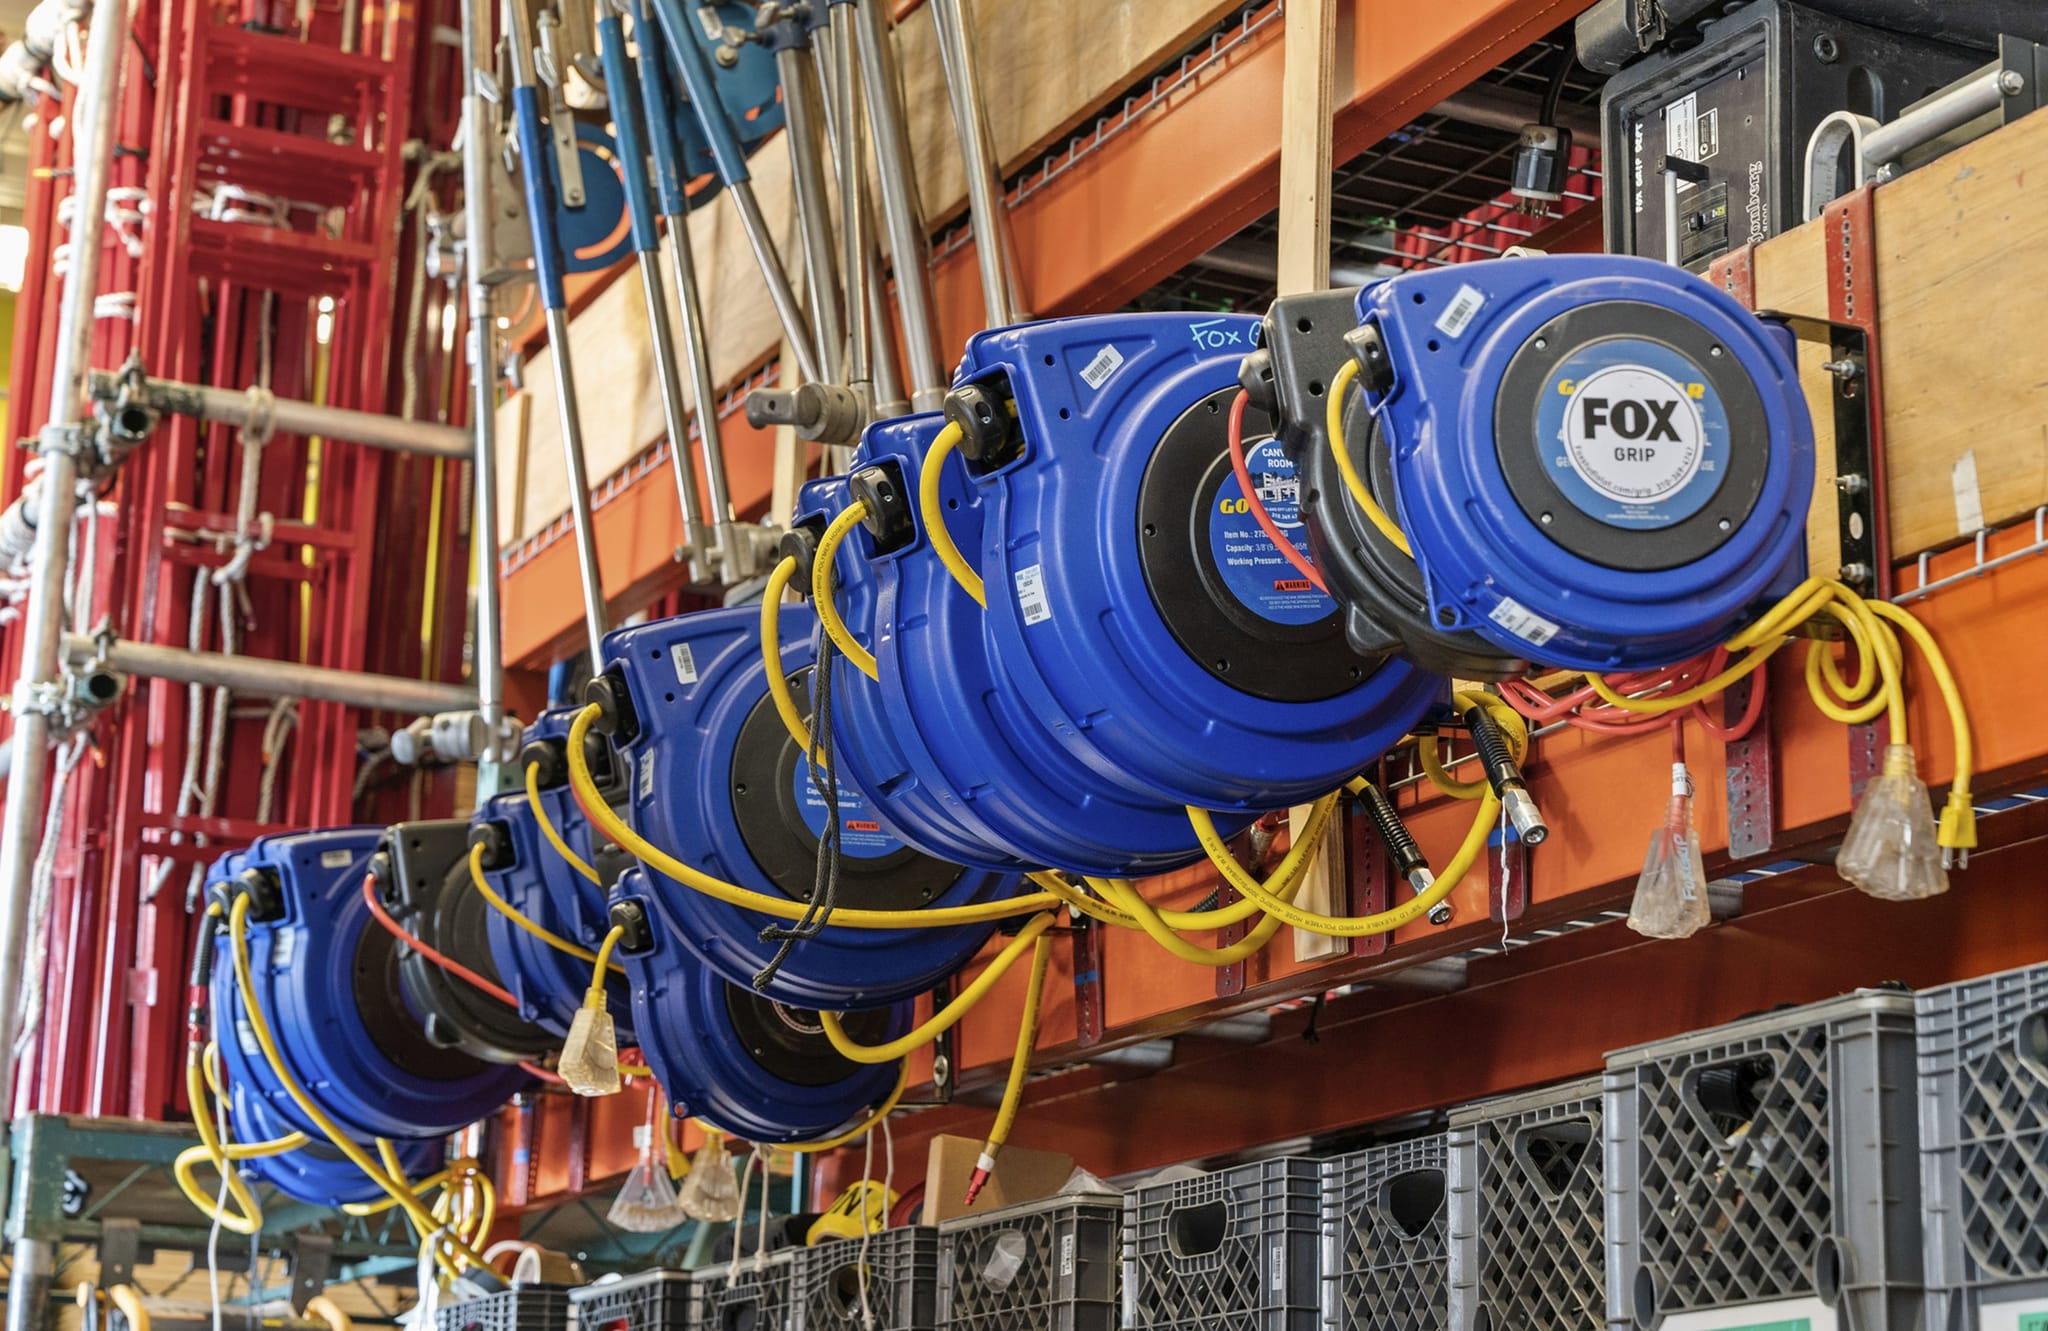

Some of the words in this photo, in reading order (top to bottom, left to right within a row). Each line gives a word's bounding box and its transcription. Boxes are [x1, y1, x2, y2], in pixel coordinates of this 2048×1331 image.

[1635, 123, 1643, 153] DEPT
[1635, 158, 1643, 187] GRIP
[1635, 190, 1643, 213] FOX
[1189, 318, 1242, 350] Fox
[1583, 397, 1682, 442] FOX
[1268, 459, 1294, 468] ROOM
[1614, 447, 1655, 462] GRIP
[1285, 912, 1303, 922] HOSE
[1305, 920, 1337, 931] POLYMER
[1338, 924, 1364, 932] HYBRID
